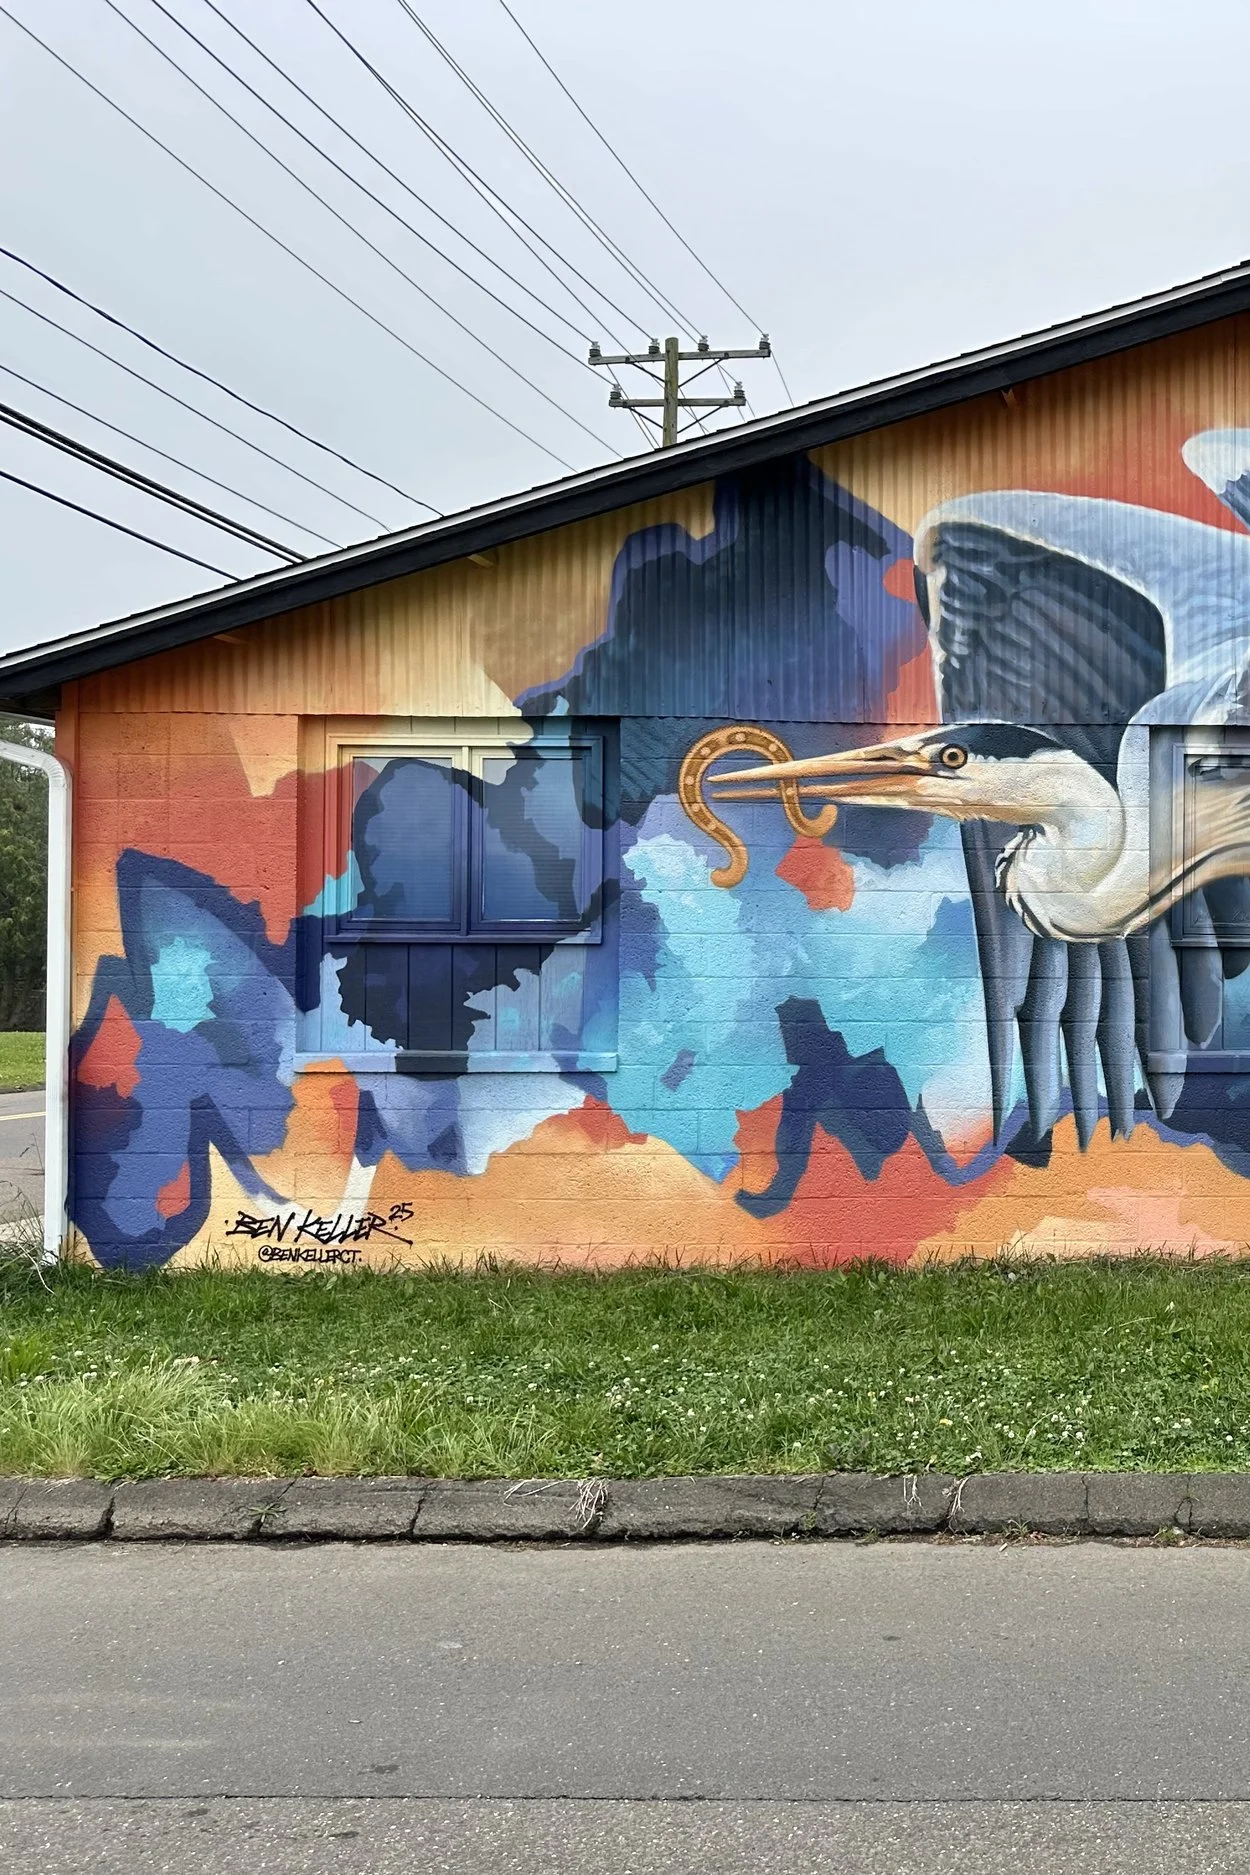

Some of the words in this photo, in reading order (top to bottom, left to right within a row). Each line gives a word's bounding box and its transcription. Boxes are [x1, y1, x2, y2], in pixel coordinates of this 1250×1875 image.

[226, 1210, 295, 1242] BEN
[293, 1209, 413, 1246] KELLER
[389, 1202, 414, 1221] 25
